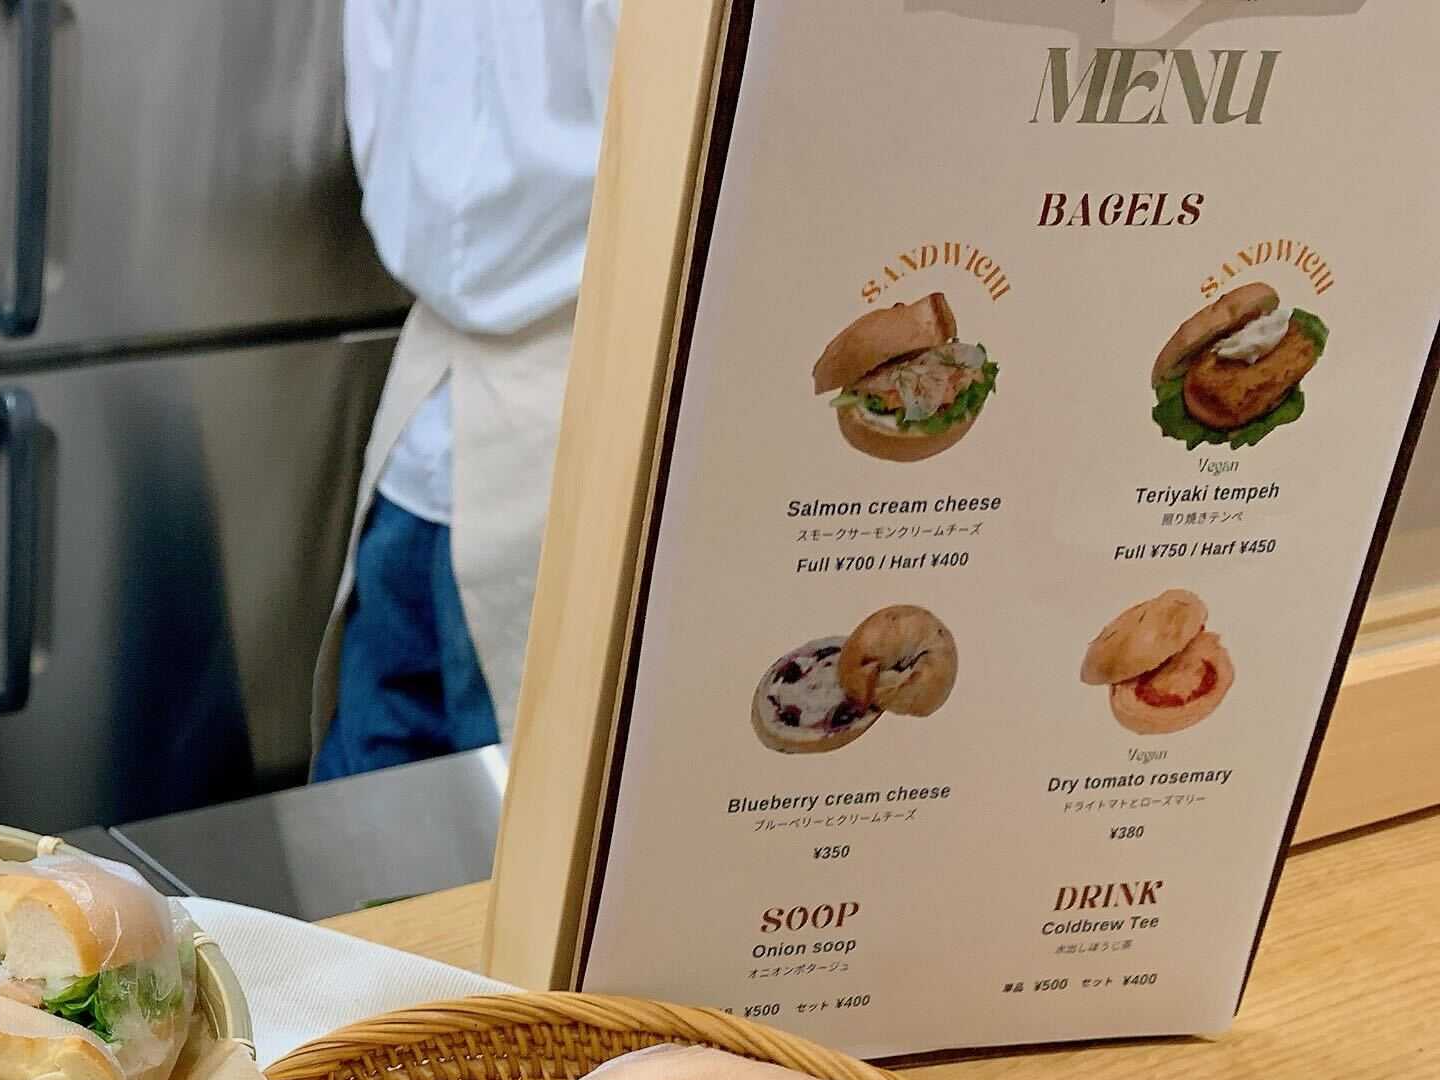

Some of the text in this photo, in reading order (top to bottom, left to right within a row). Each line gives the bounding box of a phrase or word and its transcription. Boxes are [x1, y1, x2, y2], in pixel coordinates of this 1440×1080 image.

[1028, 47, 1283, 125] MENU
[1037, 192, 1205, 227] BAGELS
[860, 240, 1013, 304] SANDWICH
[1199, 238, 1335, 298] SANDWICH
[1198, 457, 1240, 477] Vegan
[1136, 482, 1280, 506] Teriyaki tempeh
[787, 495, 1001, 517] Salmon cream cheese
[796, 521, 984, 542] スモークサーモンクリームチーズ
[1114, 544, 1145, 561] Full
[1150, 542, 1187, 559] ¥750
[1200, 541, 1235, 556] Harf
[1240, 539, 1276, 554] ¥450
[797, 555, 829, 573] Full
[836, 554, 874, 571] ¥700
[889, 553, 926, 570] Harf
[931, 552, 969, 568] ¥400
[1047, 768, 1232, 794] Dry tomato rosemary
[727, 784, 951, 814] Blueberry cream cheese
[1063, 794, 1208, 813] ドライトマトとローズマリー
[752, 807, 918, 832] ブルーベリーとクリームチーズ
[1109, 825, 1145, 840] ¥380
[813, 845, 850, 860] ¥350
[1053, 880, 1163, 911] DRINK
[760, 902, 859, 934] SOOP
[1041, 915, 1160, 936] Coldbrew Tee
[751, 939, 857, 959] Onion soop
[1034, 978, 1068, 992] ¥500
[1123, 973, 1157, 987] ¥400
[744, 1003, 780, 1018] ¥500
[796, 999, 829, 1013] セット
[836, 994, 871, 1009] ¥400
